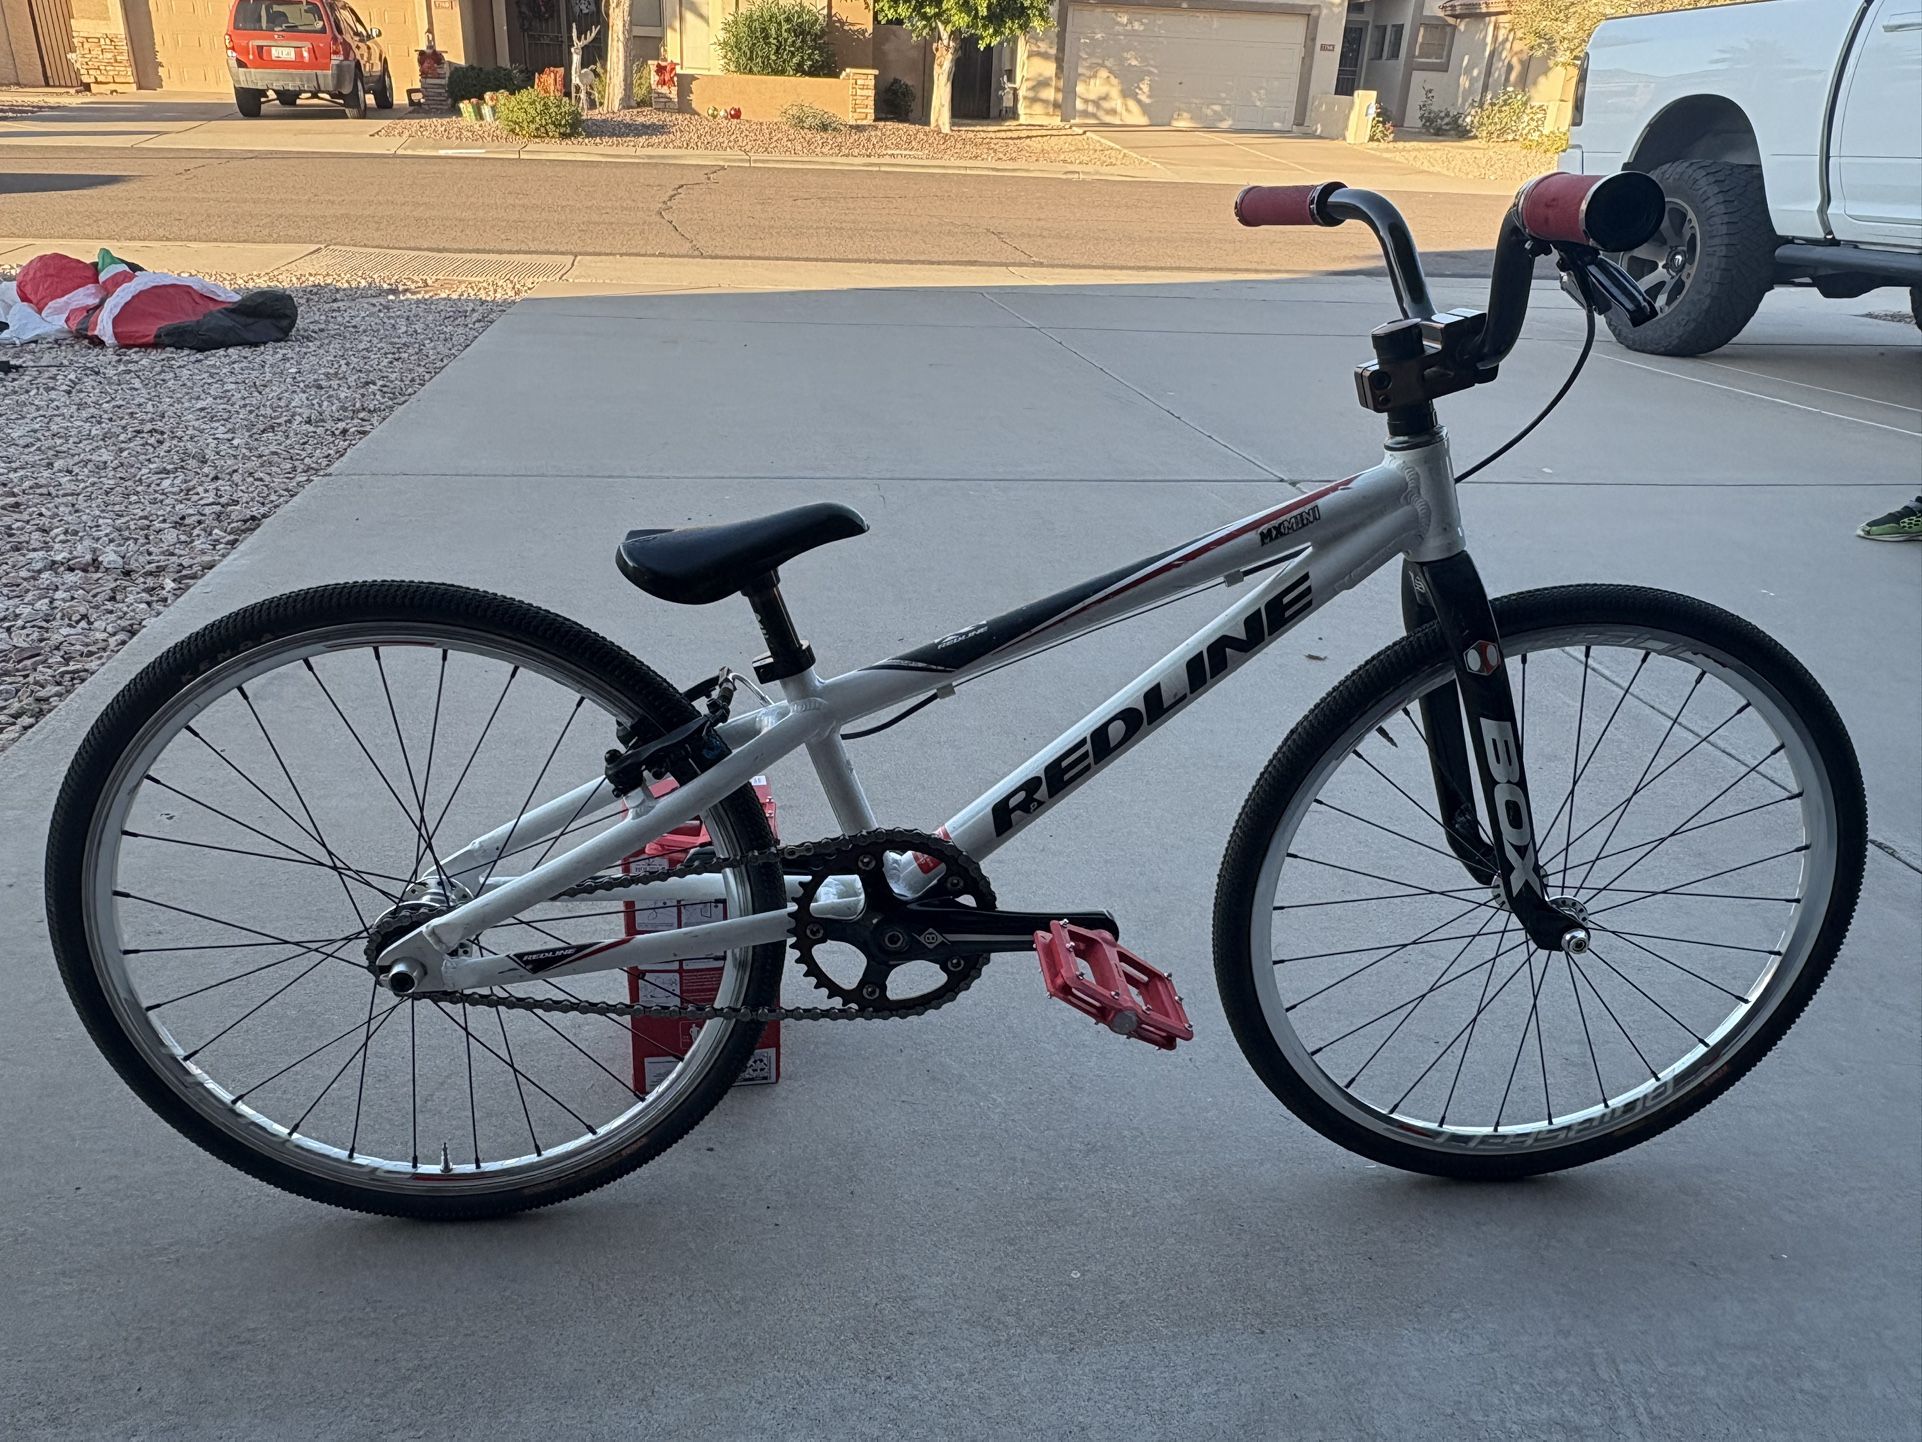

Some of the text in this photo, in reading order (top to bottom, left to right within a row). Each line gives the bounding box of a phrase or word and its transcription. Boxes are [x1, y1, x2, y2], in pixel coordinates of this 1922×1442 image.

[991, 571, 1313, 838] REDLINE
[1479, 717, 1543, 900] BOX
[522, 948, 577, 961] REDLINE
